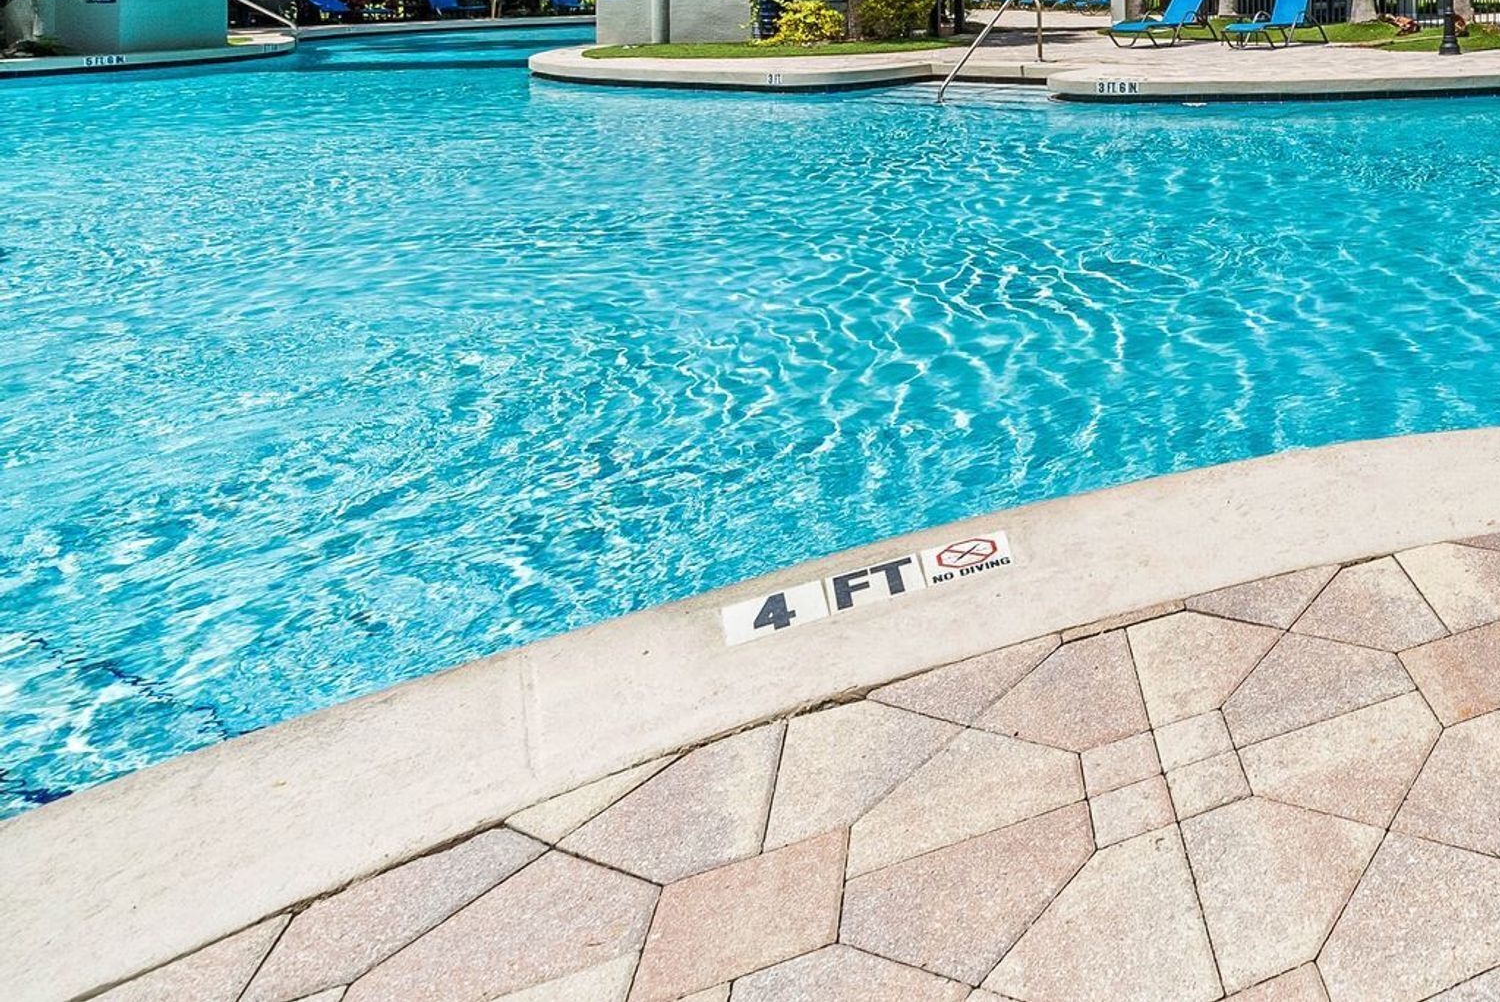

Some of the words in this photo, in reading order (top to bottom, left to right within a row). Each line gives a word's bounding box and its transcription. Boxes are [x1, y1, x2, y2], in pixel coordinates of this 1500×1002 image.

[1098, 82, 1105, 93] 3
[1119, 82, 1127, 93] 6
[932, 571, 954, 584] NO
[960, 556, 1011, 577] DIVING
[753, 592, 796, 630] 4
[833, 557, 912, 611] FT
